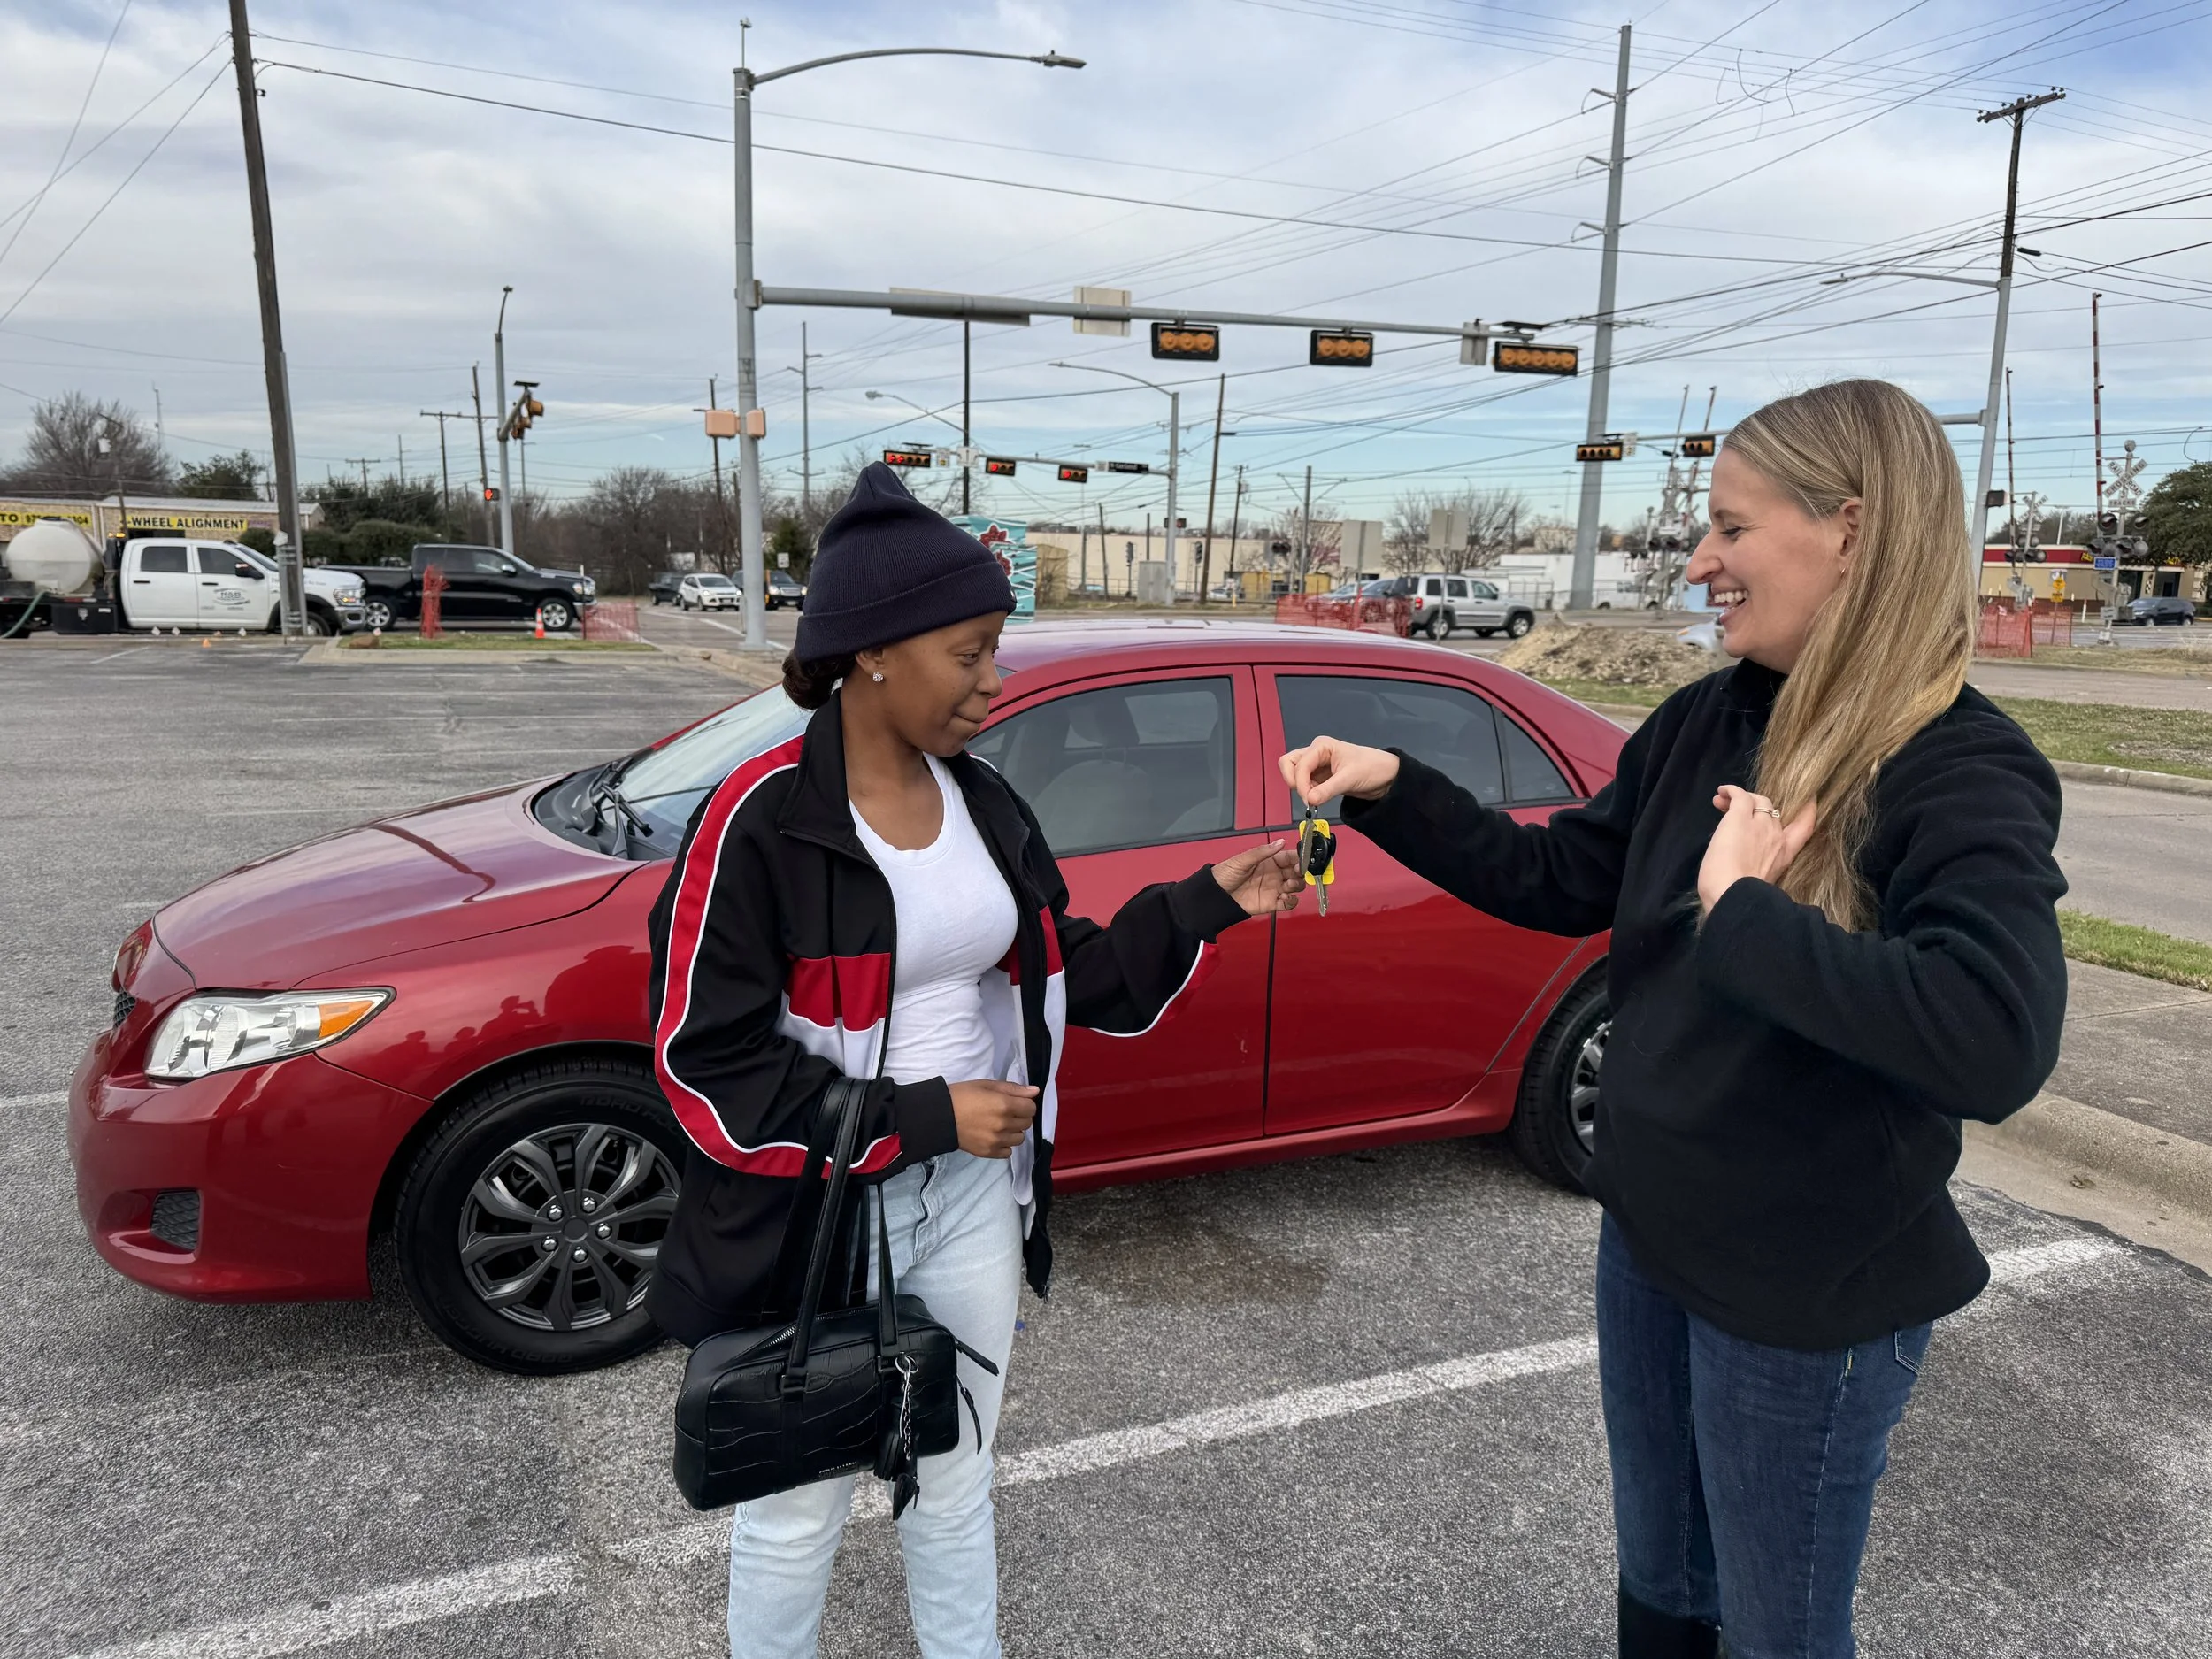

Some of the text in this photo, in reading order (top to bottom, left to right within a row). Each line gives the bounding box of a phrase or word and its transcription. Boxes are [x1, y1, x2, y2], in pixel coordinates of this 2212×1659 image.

[2106, 463, 2145, 495] CROSSING
[131, 517, 174, 527] WHEEL
[176, 518, 245, 529] ALIGNMENT
